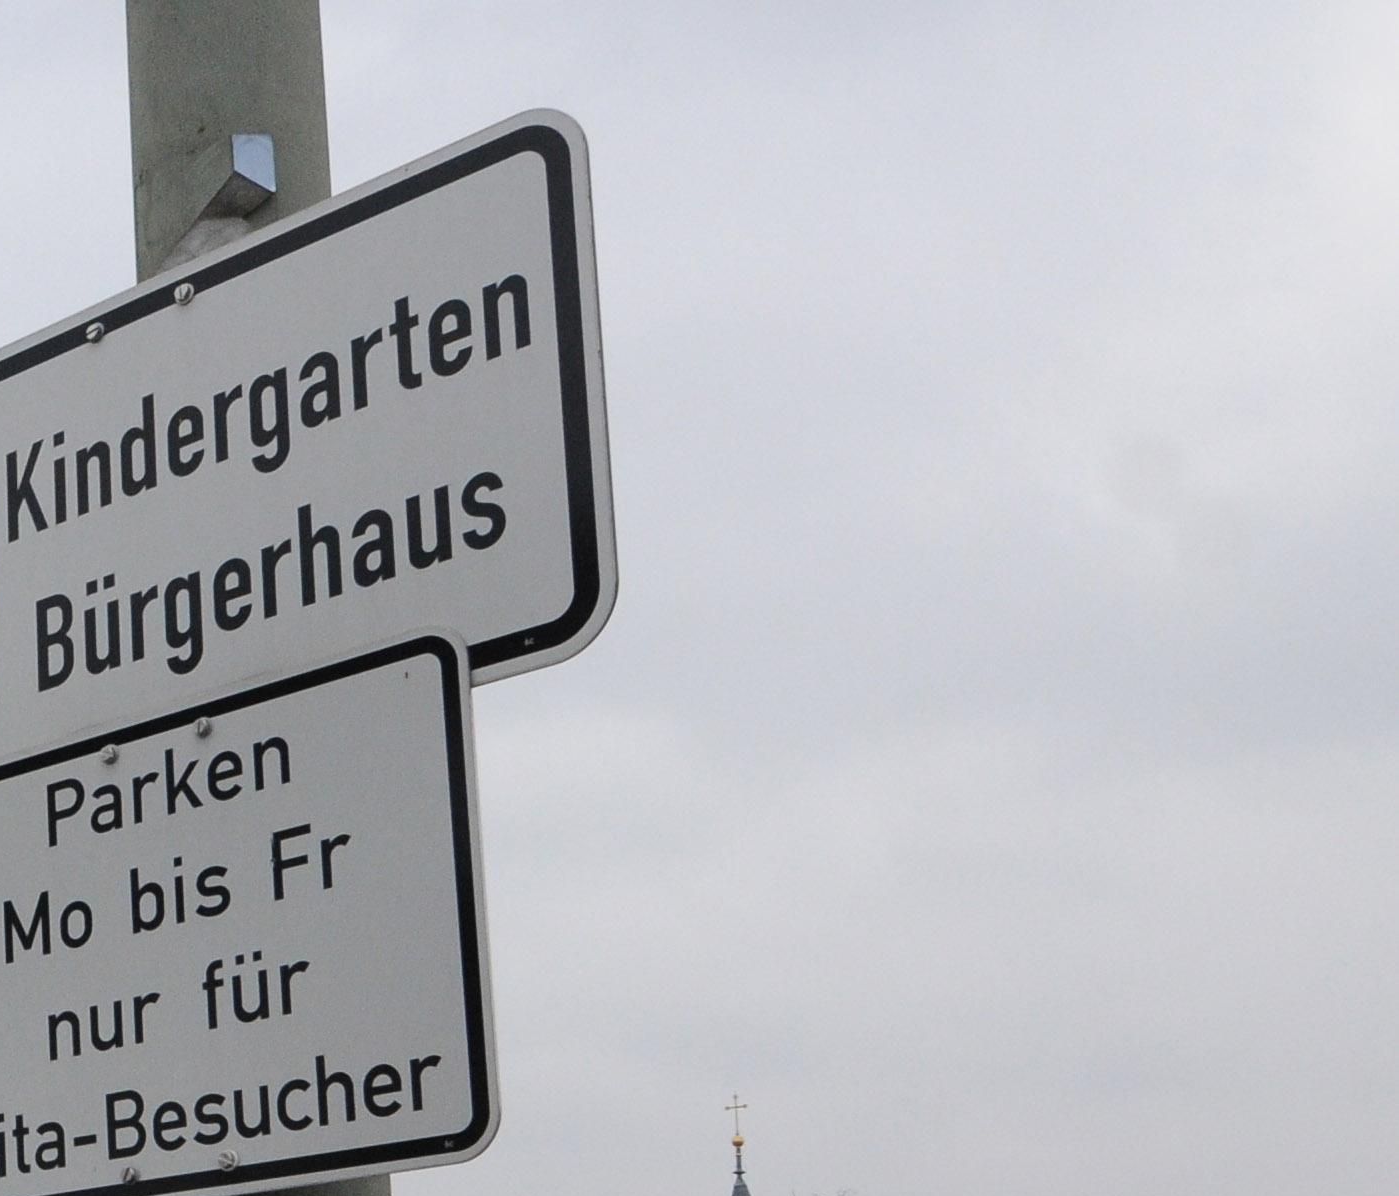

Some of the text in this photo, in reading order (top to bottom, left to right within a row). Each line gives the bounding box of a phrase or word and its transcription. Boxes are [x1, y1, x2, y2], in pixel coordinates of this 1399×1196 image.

[5, 274, 532, 544] Kindergarten
[35, 471, 507, 693] Bürgerhaus
[45, 736, 292, 847] Parken
[3, 823, 351, 963] Mo bis Fr
[47, 951, 310, 1061] nur für
